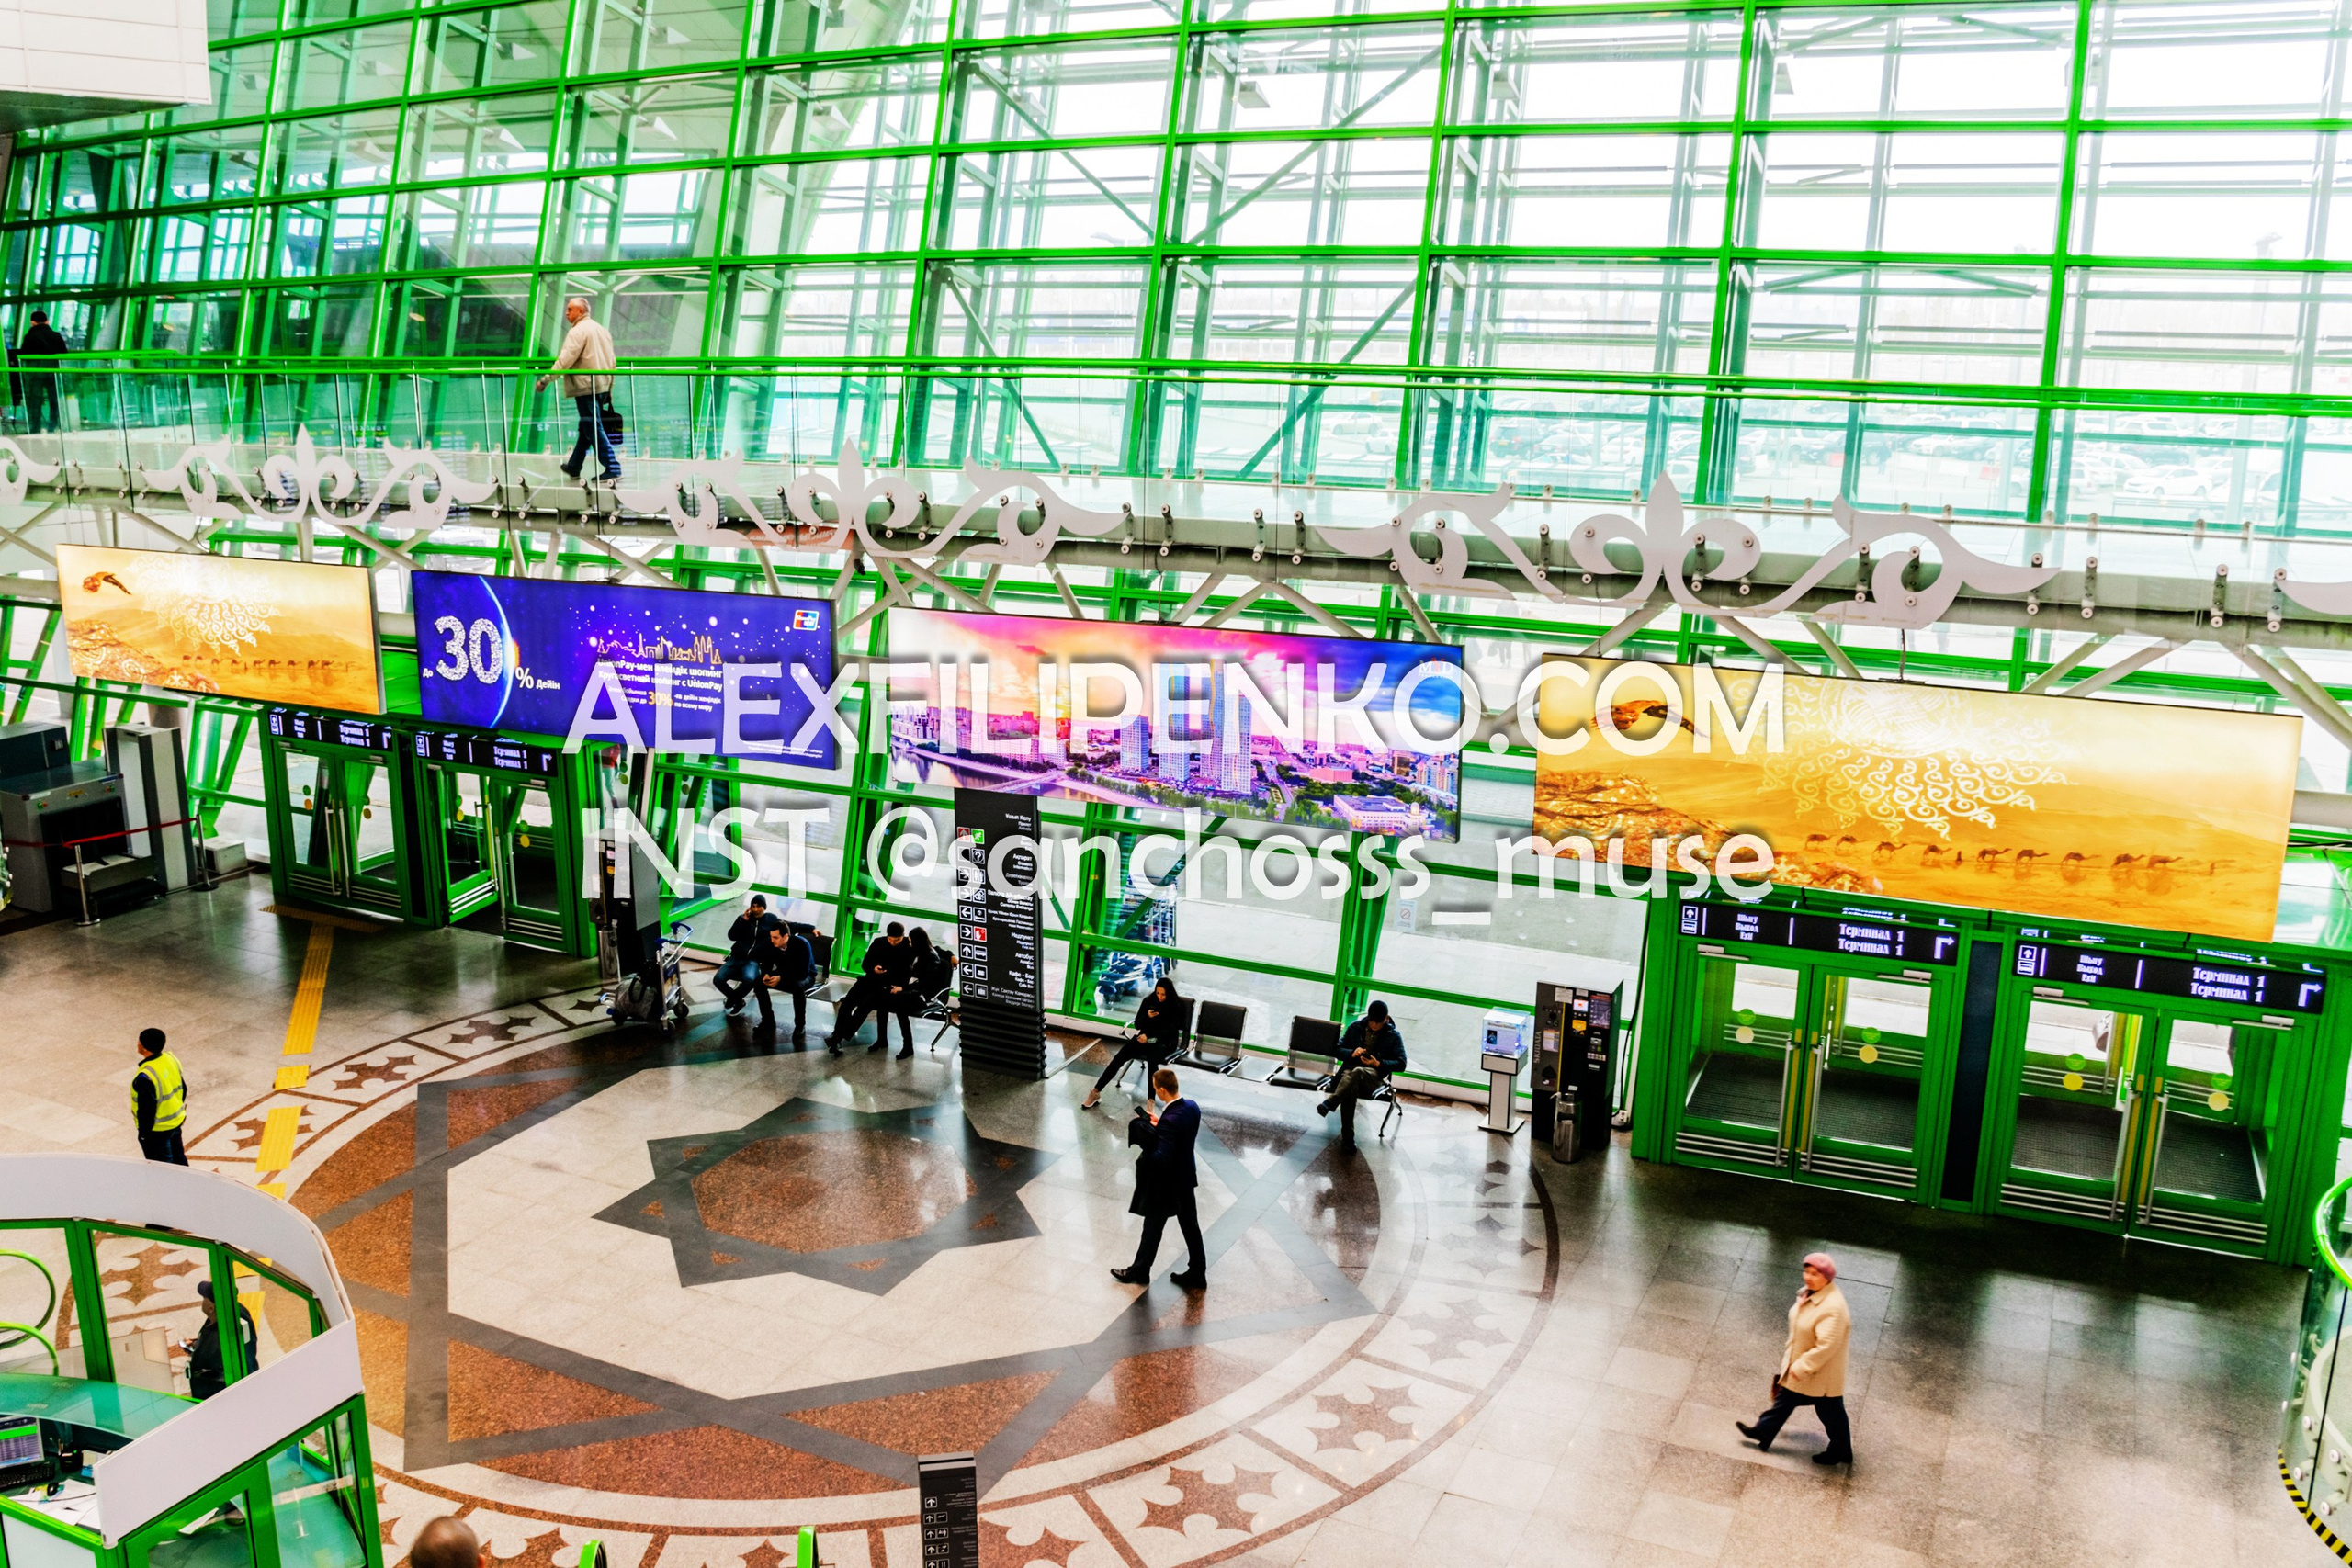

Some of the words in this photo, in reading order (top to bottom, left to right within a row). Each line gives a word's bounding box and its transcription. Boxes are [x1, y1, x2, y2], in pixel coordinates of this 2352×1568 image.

[422, 668, 434, 679] До
[434, 615, 503, 684] 30
[689, 668, 723, 679] шопинг
[687, 679, 723, 693] UnionPay
[648, 691, 673, 706] 30%
[1839, 923, 1891, 941] Терминал
[1896, 930, 1905, 942] 1
[1838, 938, 1890, 955] Терминал
[1895, 944, 1903, 956] 1
[2192, 966, 2251, 986] Терминал
[2256, 975, 2266, 987] 1
[2190, 982, 2248, 1001] Терминал
[2255, 990, 2263, 1002] 1
